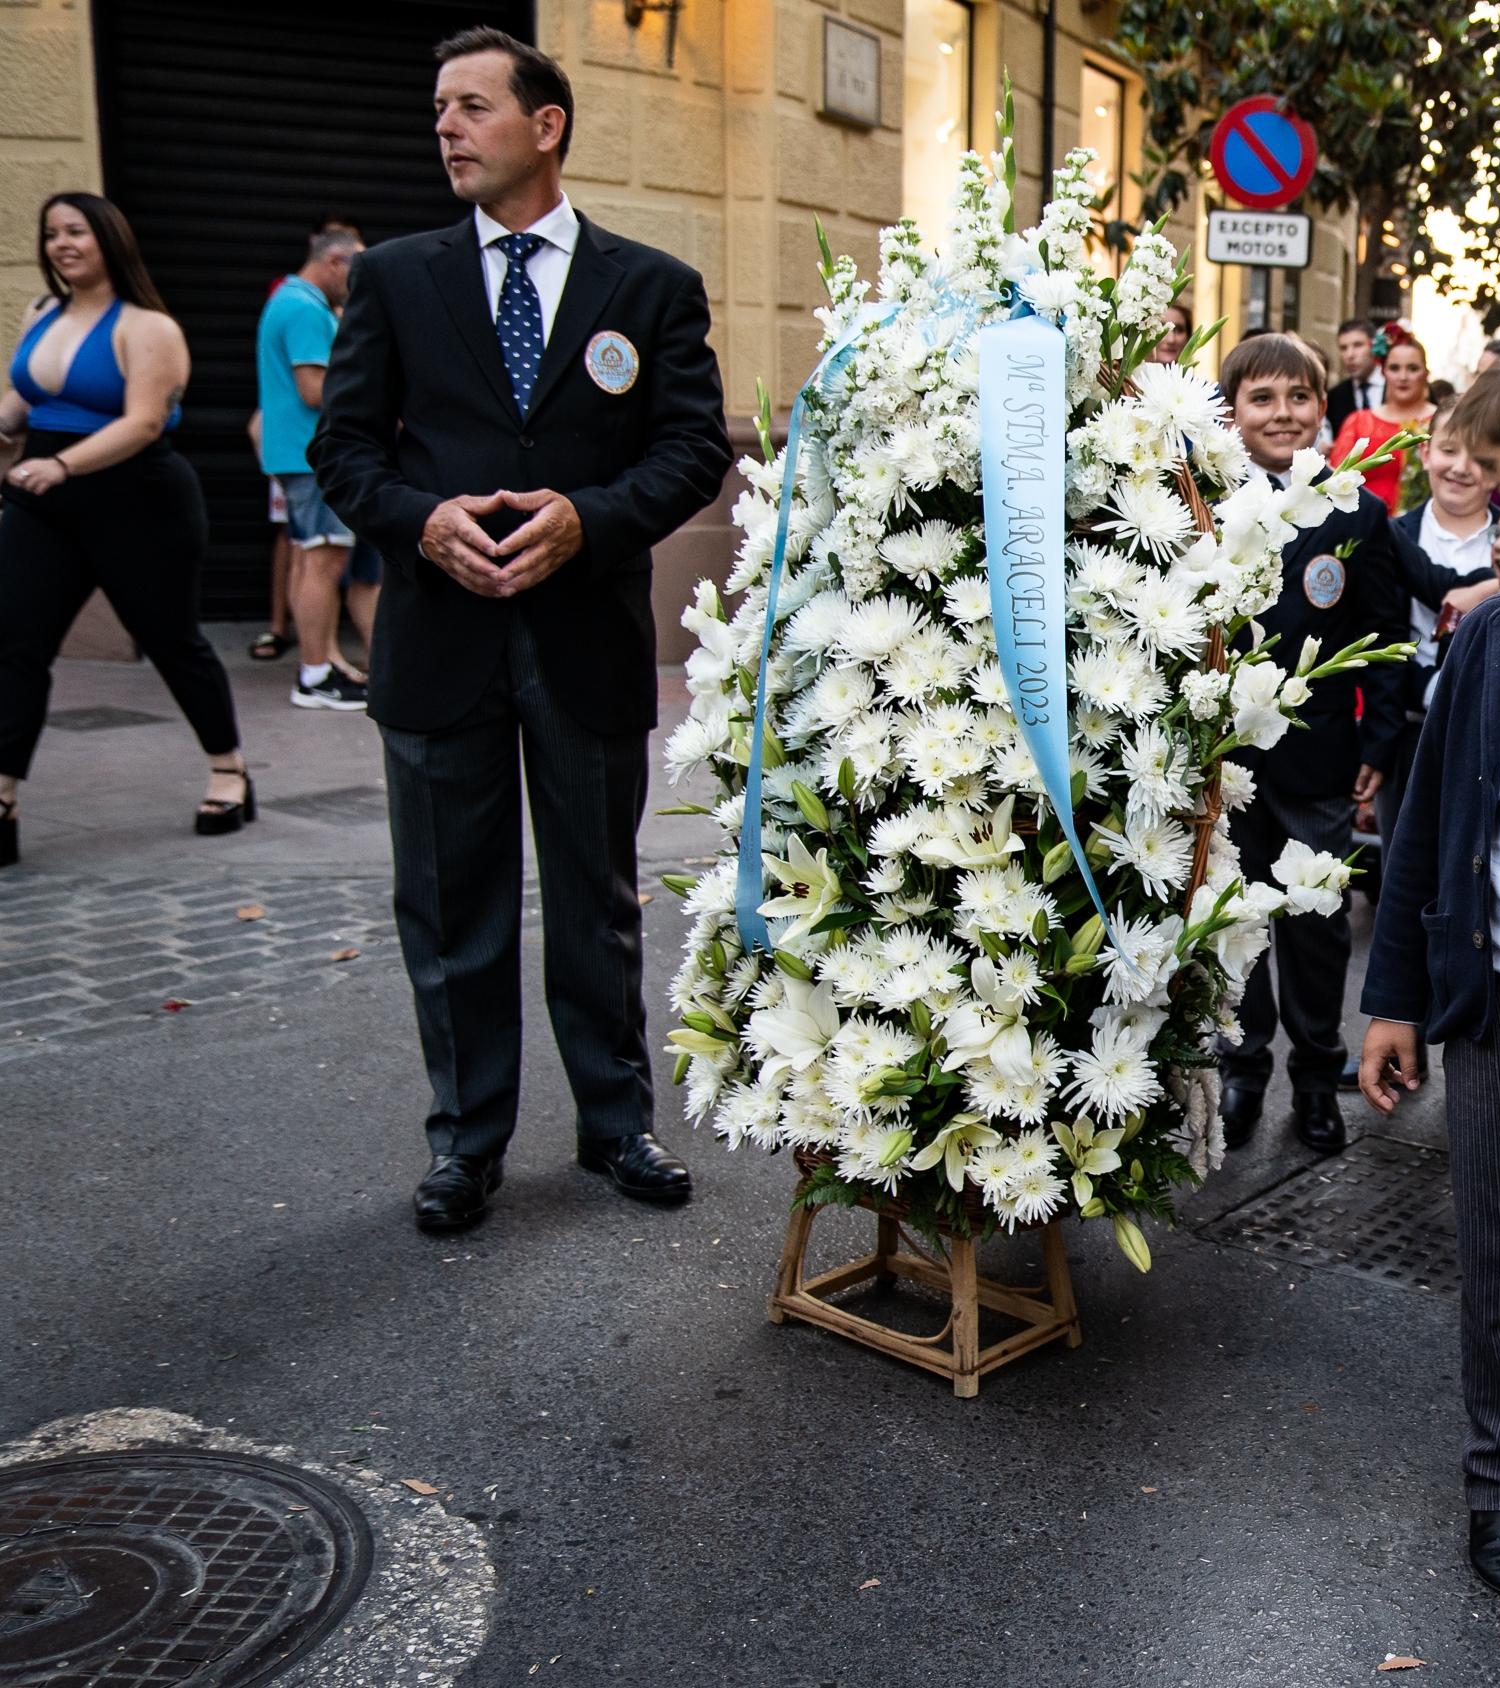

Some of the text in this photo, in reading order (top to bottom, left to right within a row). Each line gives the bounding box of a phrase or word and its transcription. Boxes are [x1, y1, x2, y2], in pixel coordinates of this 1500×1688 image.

[1219, 218, 1299, 237] EXCEPTO
[1227, 241, 1288, 257] MOTOS
[1001, 397, 1050, 491] STMA.
[1001, 499, 1047, 649] ARACELI
[1016, 661, 1050, 727] 2023
